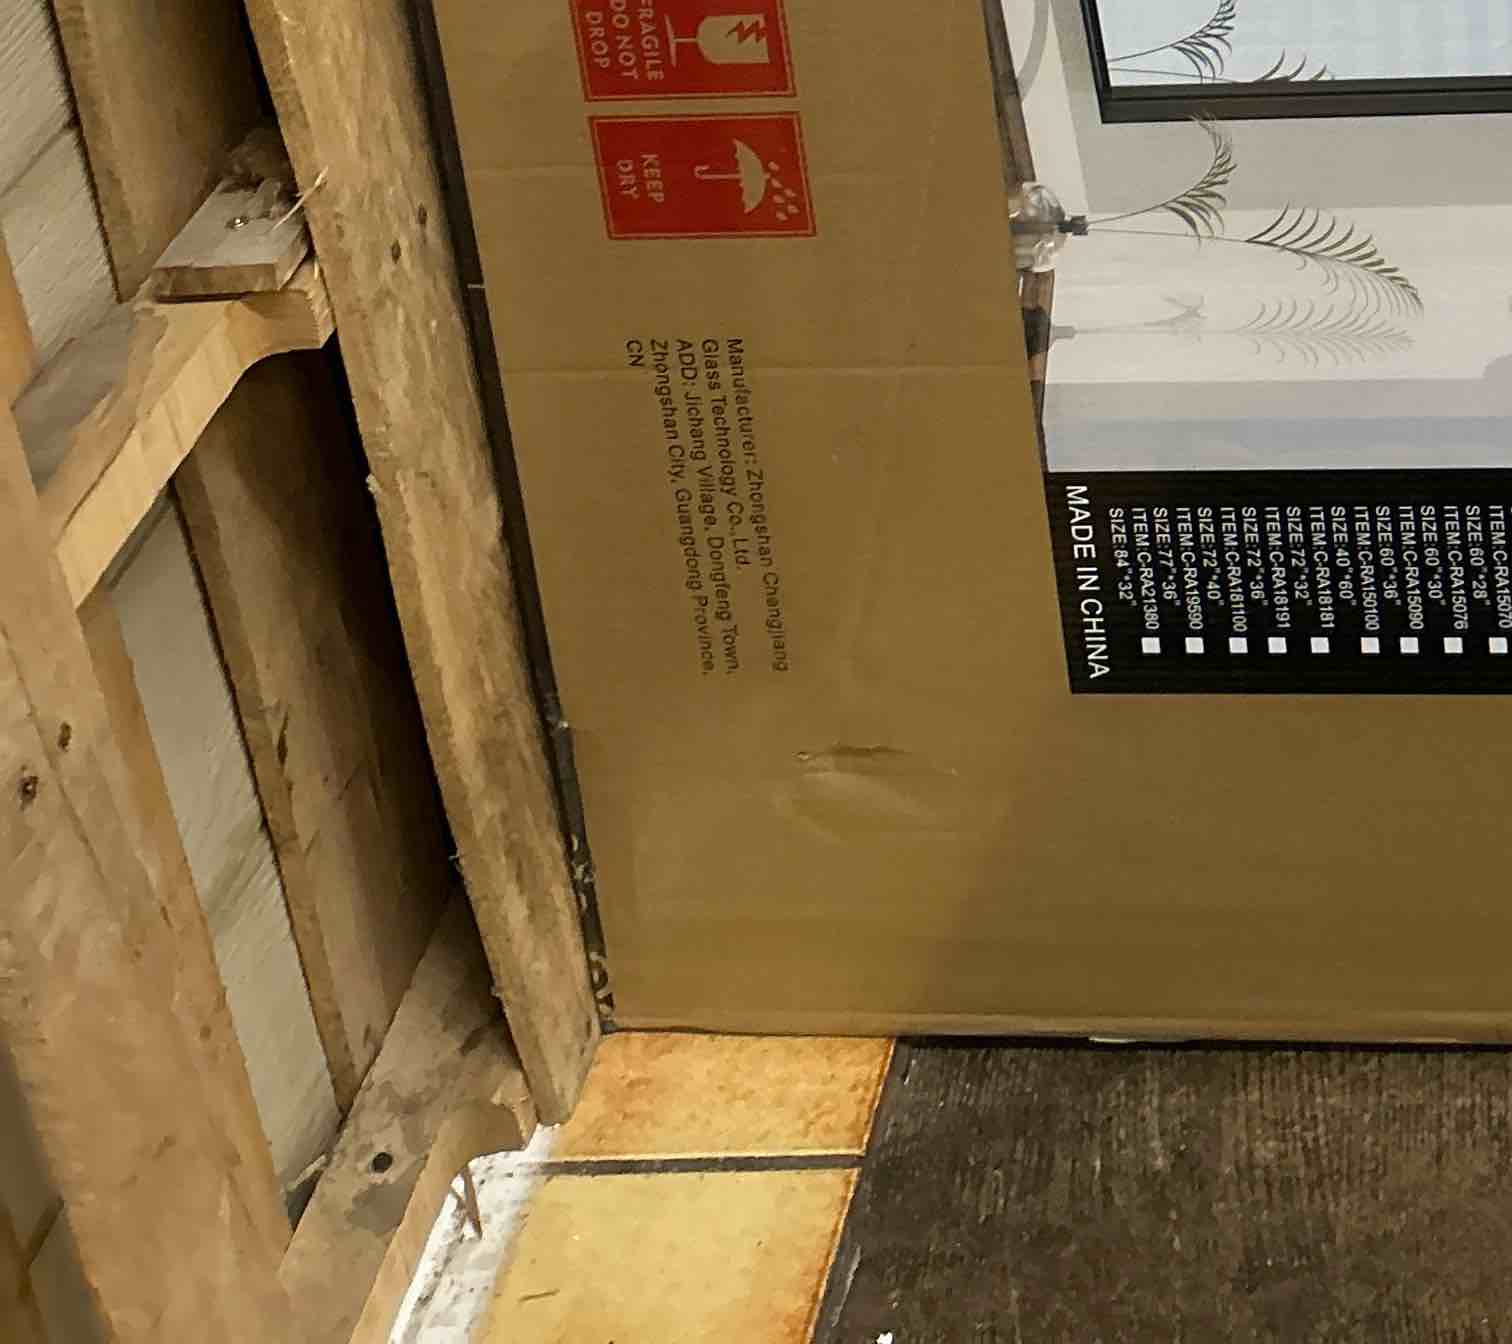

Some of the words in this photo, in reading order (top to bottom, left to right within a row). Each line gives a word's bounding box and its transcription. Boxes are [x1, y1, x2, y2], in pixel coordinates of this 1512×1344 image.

[585, 10, 610, 69] DROP
[615, 35, 638, 81] NOT
[616, 159, 639, 200] DRY
[639, 153, 665, 203] KEEP
[626, 340, 644, 367] CN
[675, 339, 698, 386] ADD:
[701, 339, 720, 390] Glass
[650, 339, 680, 440] Zhongshan
[683, 391, 709, 461] Jichang
[710, 395, 742, 497] Technology
[727, 339, 759, 465] Manufacturer:
[746, 469, 775, 567] Zhongshan
[665, 445, 686, 484] City,
[691, 465, 718, 531] Village,
[1066, 486, 1096, 558] MADE
[674, 489, 702, 591] Guangdong
[707, 536, 731, 621] Dongfeng
[1076, 567, 1100, 591] IN
[691, 594, 716, 675] Province,
[720, 624, 739, 675] Town,
[1081, 598, 1110, 678] CHINA
